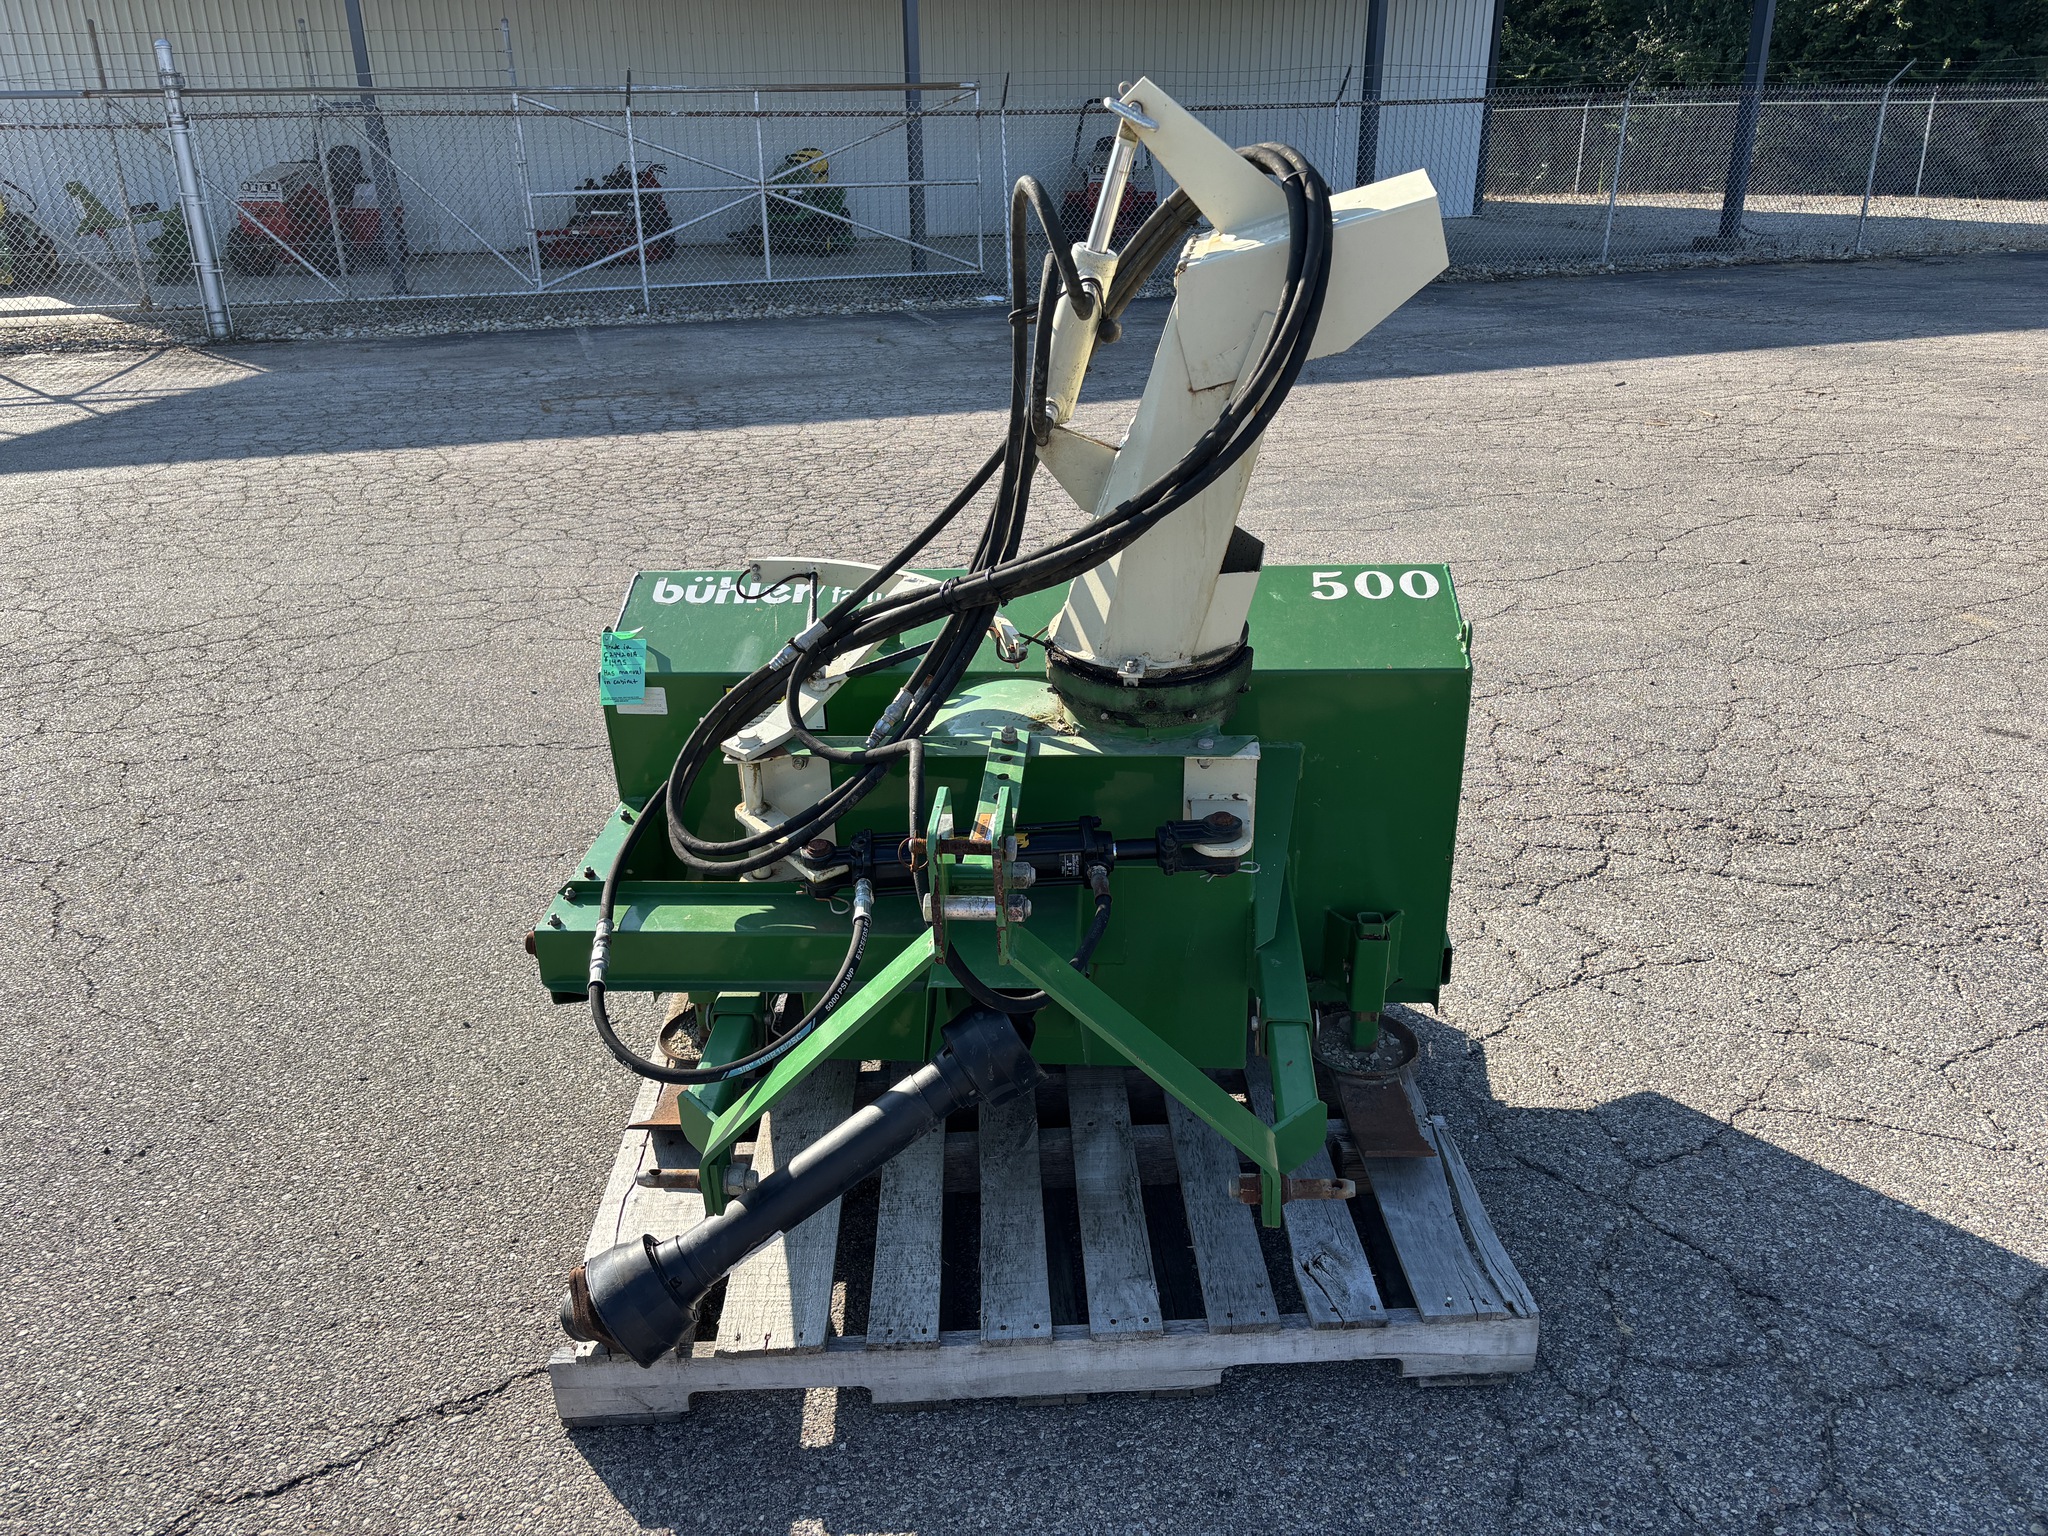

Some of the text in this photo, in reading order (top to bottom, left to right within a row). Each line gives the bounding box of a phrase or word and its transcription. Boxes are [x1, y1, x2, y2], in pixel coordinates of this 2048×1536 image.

[652, 576, 811, 605] bühler
[1310, 569, 1440, 600] 500
[619, 667, 642, 675] manual
[824, 993, 840, 1012] 5000
[837, 980, 849, 995] PSI
[844, 967, 855, 982] WP
[855, 927, 869, 961] EXCEEDS
